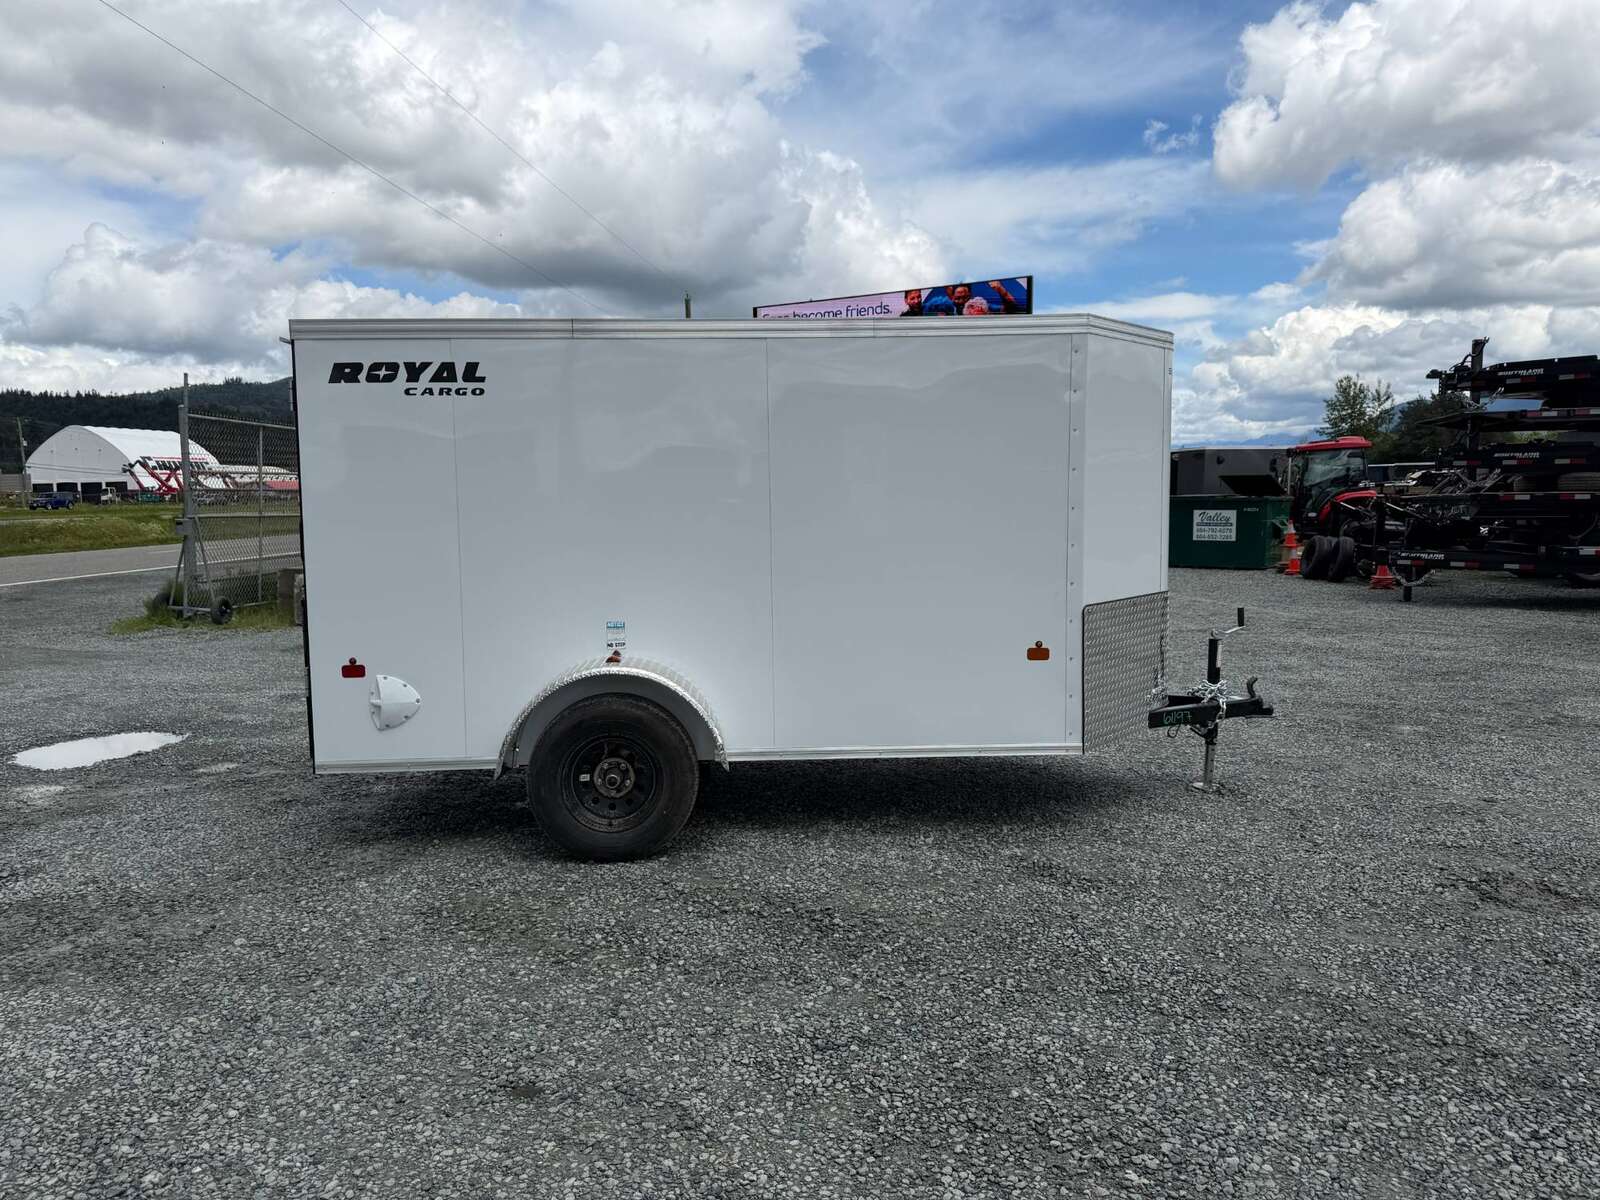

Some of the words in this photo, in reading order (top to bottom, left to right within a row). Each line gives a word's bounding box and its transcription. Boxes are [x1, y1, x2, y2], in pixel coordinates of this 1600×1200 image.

[845, 302, 893, 318] friends.
[328, 361, 486, 383] ROYAL
[404, 387, 485, 396] CARGO
[1198, 512, 1231, 521] Valley
